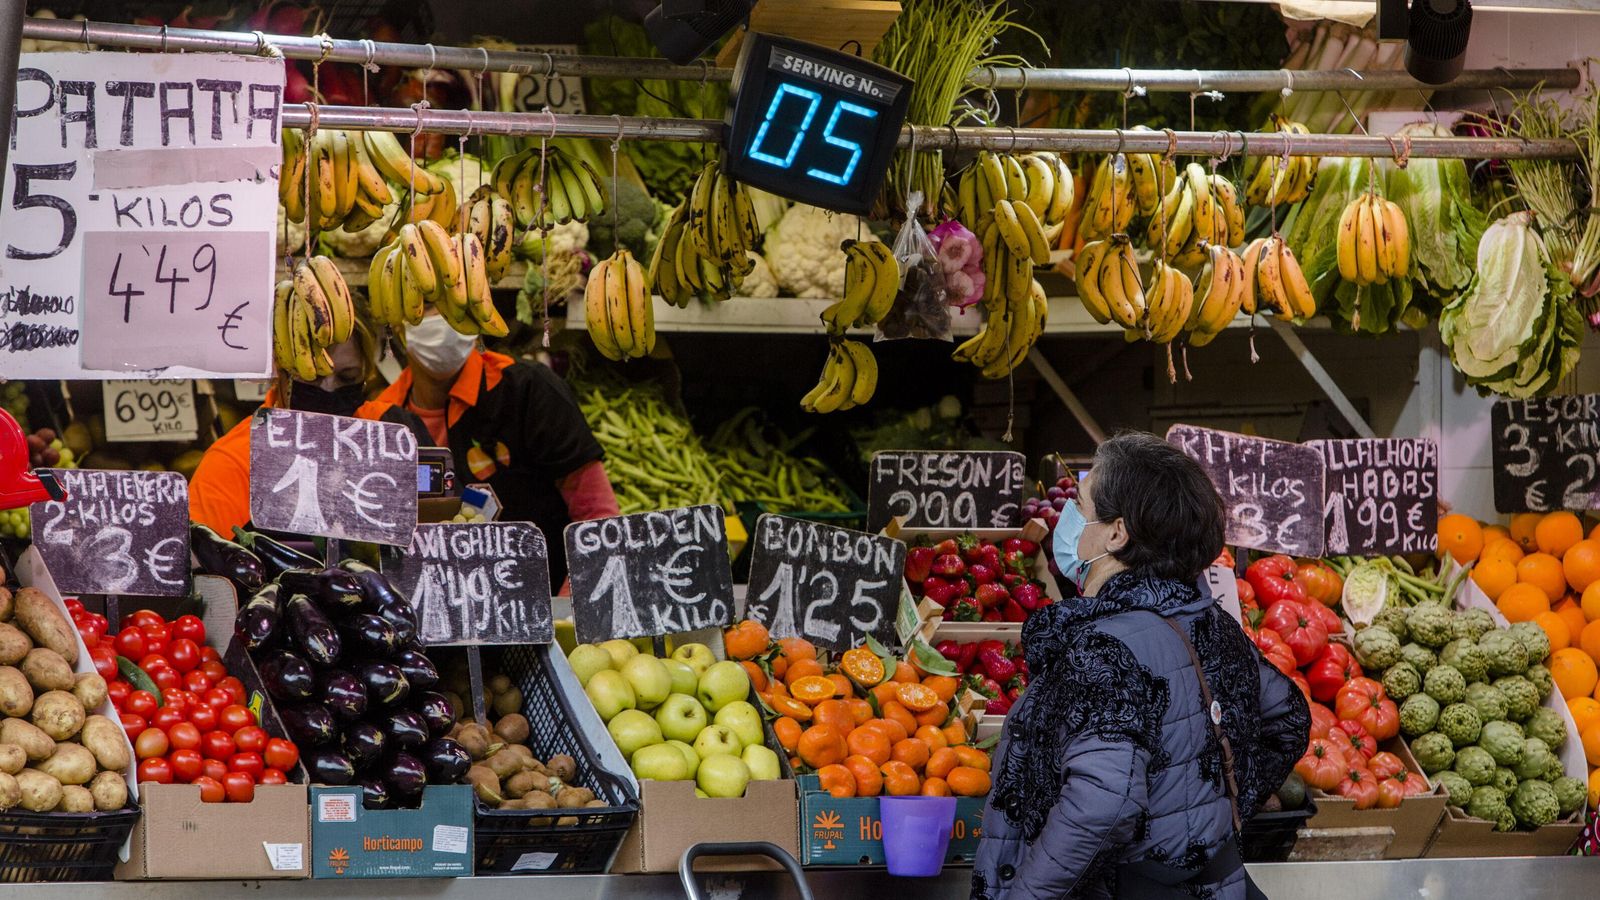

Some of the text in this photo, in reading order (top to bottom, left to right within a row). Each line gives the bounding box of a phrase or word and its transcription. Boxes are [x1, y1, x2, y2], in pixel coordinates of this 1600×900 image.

[782, 56, 884, 98] SERVING No.
[11, 67, 282, 150] PATATA
[749, 82, 879, 186] 05
[112, 193, 233, 228] KILOS
[108, 243, 217, 323] 4'49
[217, 301, 250, 350] €
[115, 390, 179, 423] 6'99
[153, 421, 182, 434] KILO
[266, 411, 415, 466] EL KILO
[876, 454, 993, 489] FRESON
[1228, 469, 1306, 508] KILOS
[1342, 468, 1435, 499] HABAS
[272, 454, 397, 534] 1 €
[888, 490, 978, 528] 2'99
[1525, 480, 1549, 512] €
[575, 505, 722, 554] GOLDEN
[1324, 491, 1425, 554] 1'99 €
[1403, 532, 1438, 552] KILO
[88, 527, 184, 591] 3 €
[764, 517, 897, 575] BONBON
[411, 560, 524, 642] 1'49 €
[589, 545, 707, 638] 1 €
[759, 561, 882, 643] 1'25
[493, 595, 552, 637] KILO
[652, 599, 729, 634] KILO
[364, 835, 424, 853] Horticampo
[814, 831, 844, 840] FRUPAL
